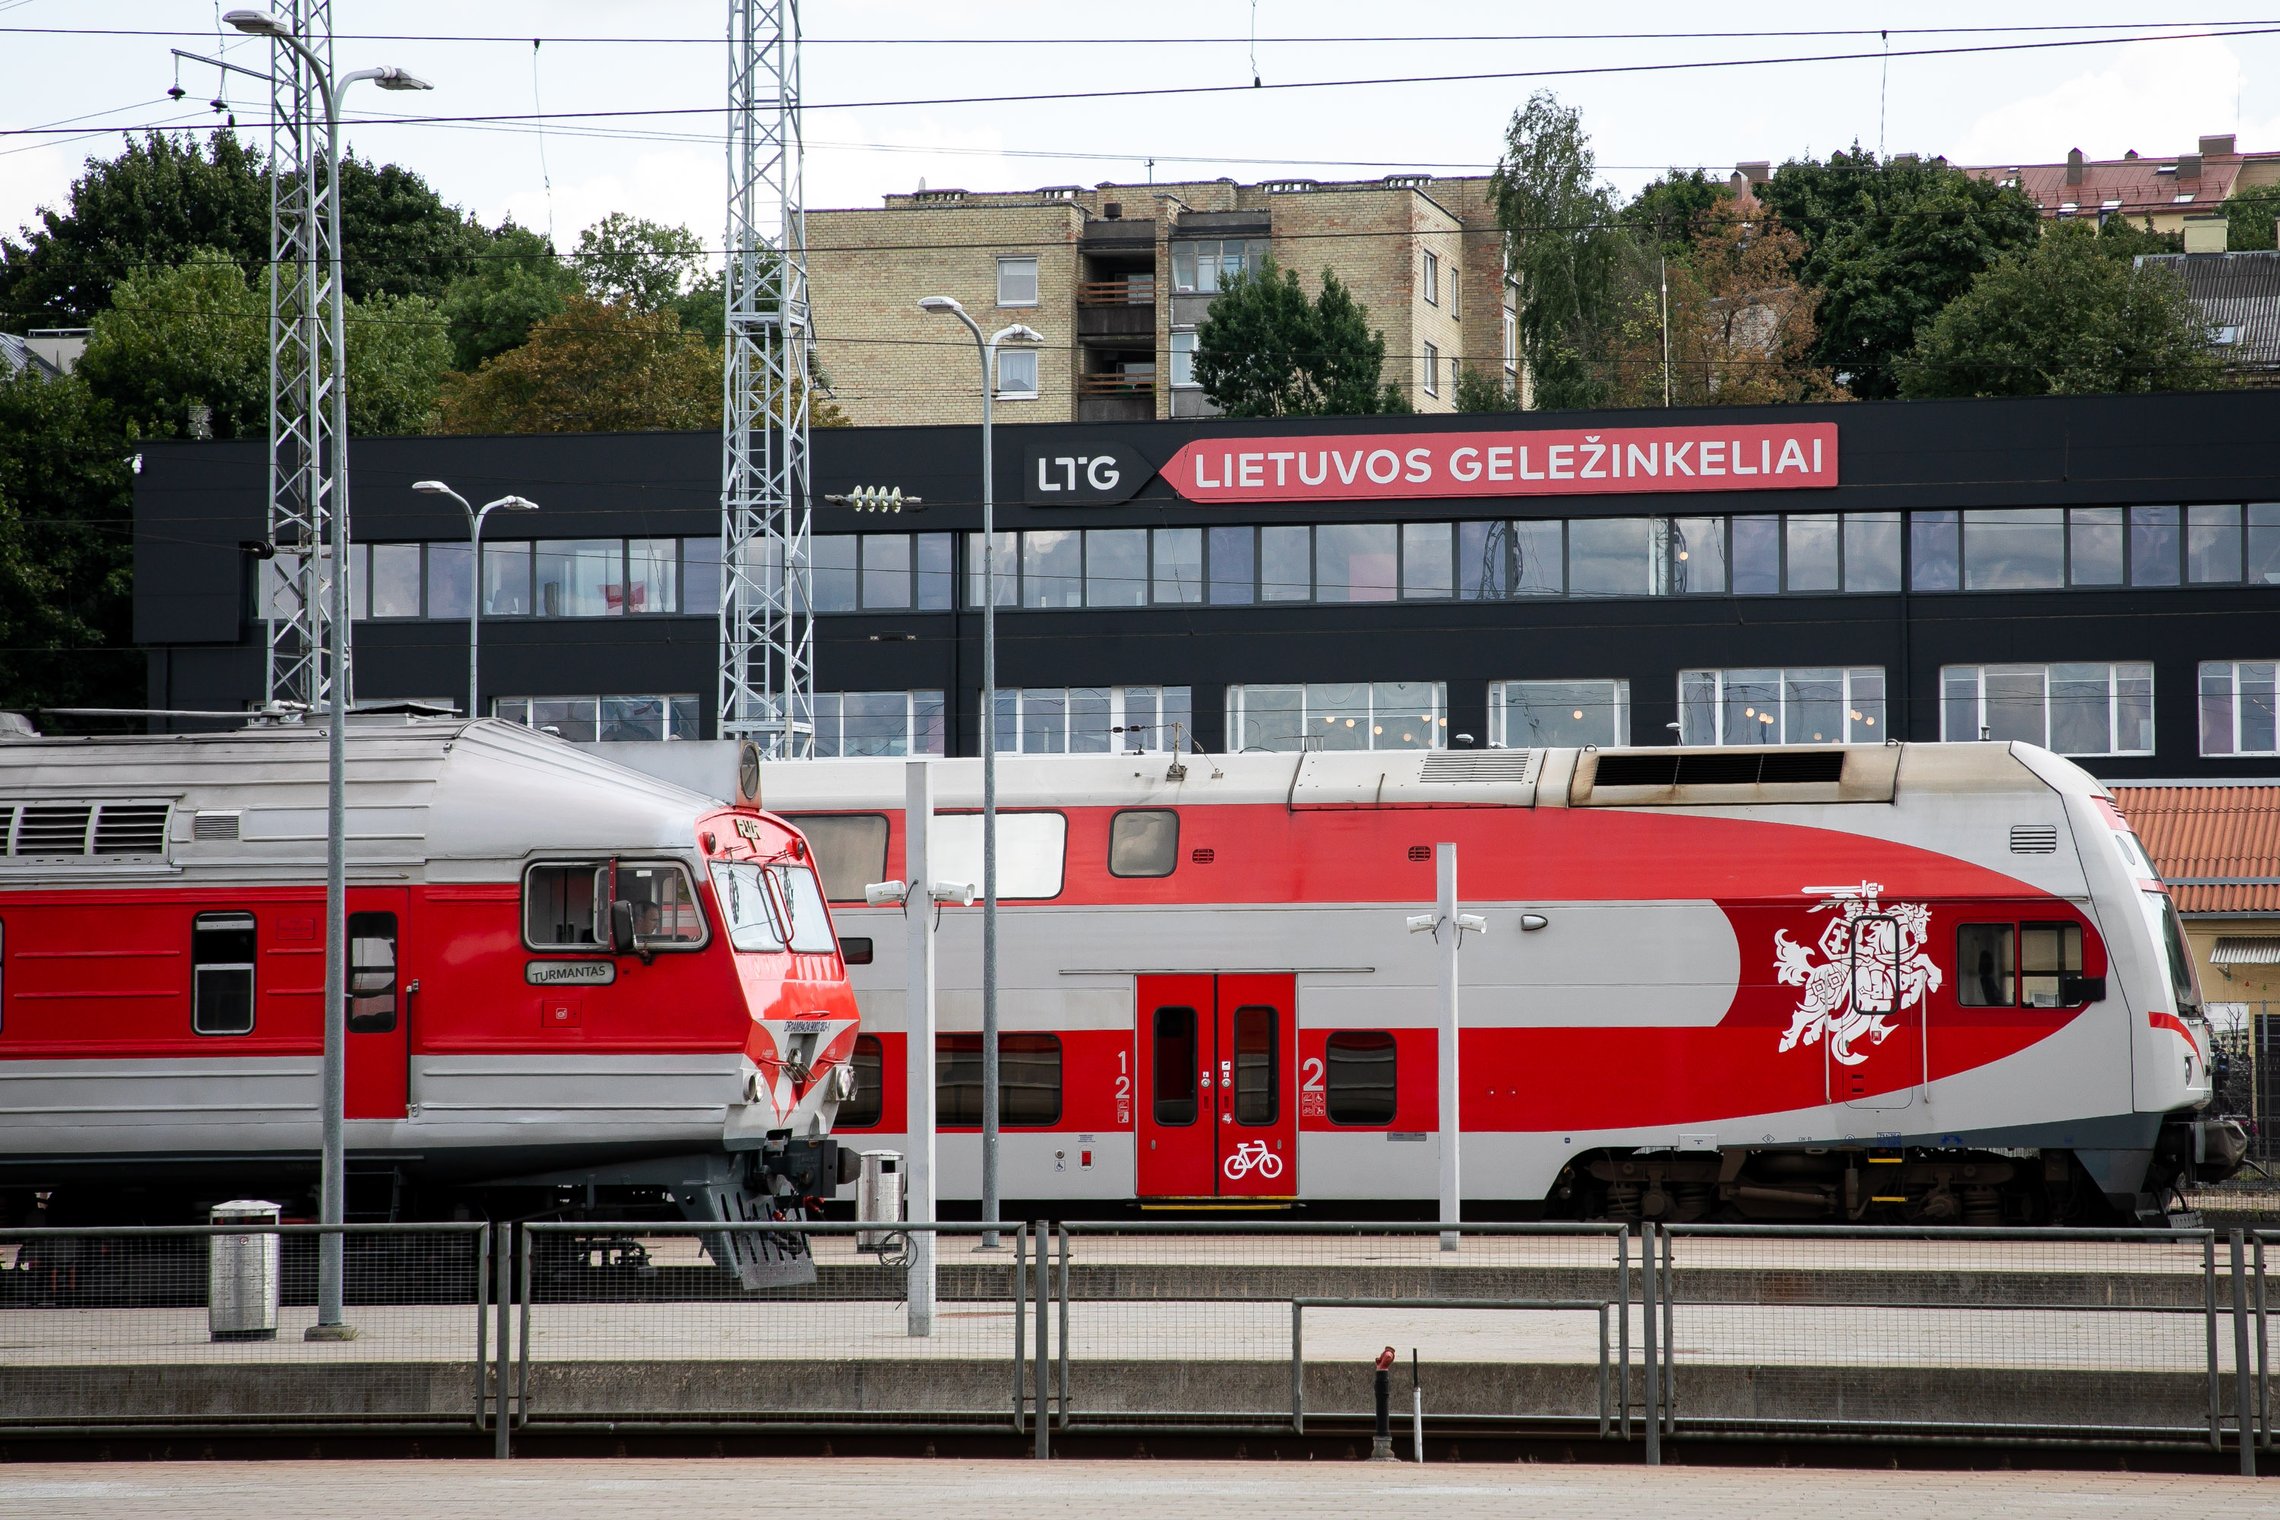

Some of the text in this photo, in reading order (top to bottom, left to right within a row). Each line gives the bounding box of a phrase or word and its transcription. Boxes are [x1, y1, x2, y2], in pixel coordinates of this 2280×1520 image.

[1038, 455, 1120, 492] LTG
[1195, 435, 1823, 488] LIETUVOS GELEŽINKELIAI
[532, 965, 606, 983] TURMANTAS
[1117, 1050, 1127, 1074] 1
[1302, 1057, 1324, 1092] 2
[1115, 1075, 1130, 1099] 2
